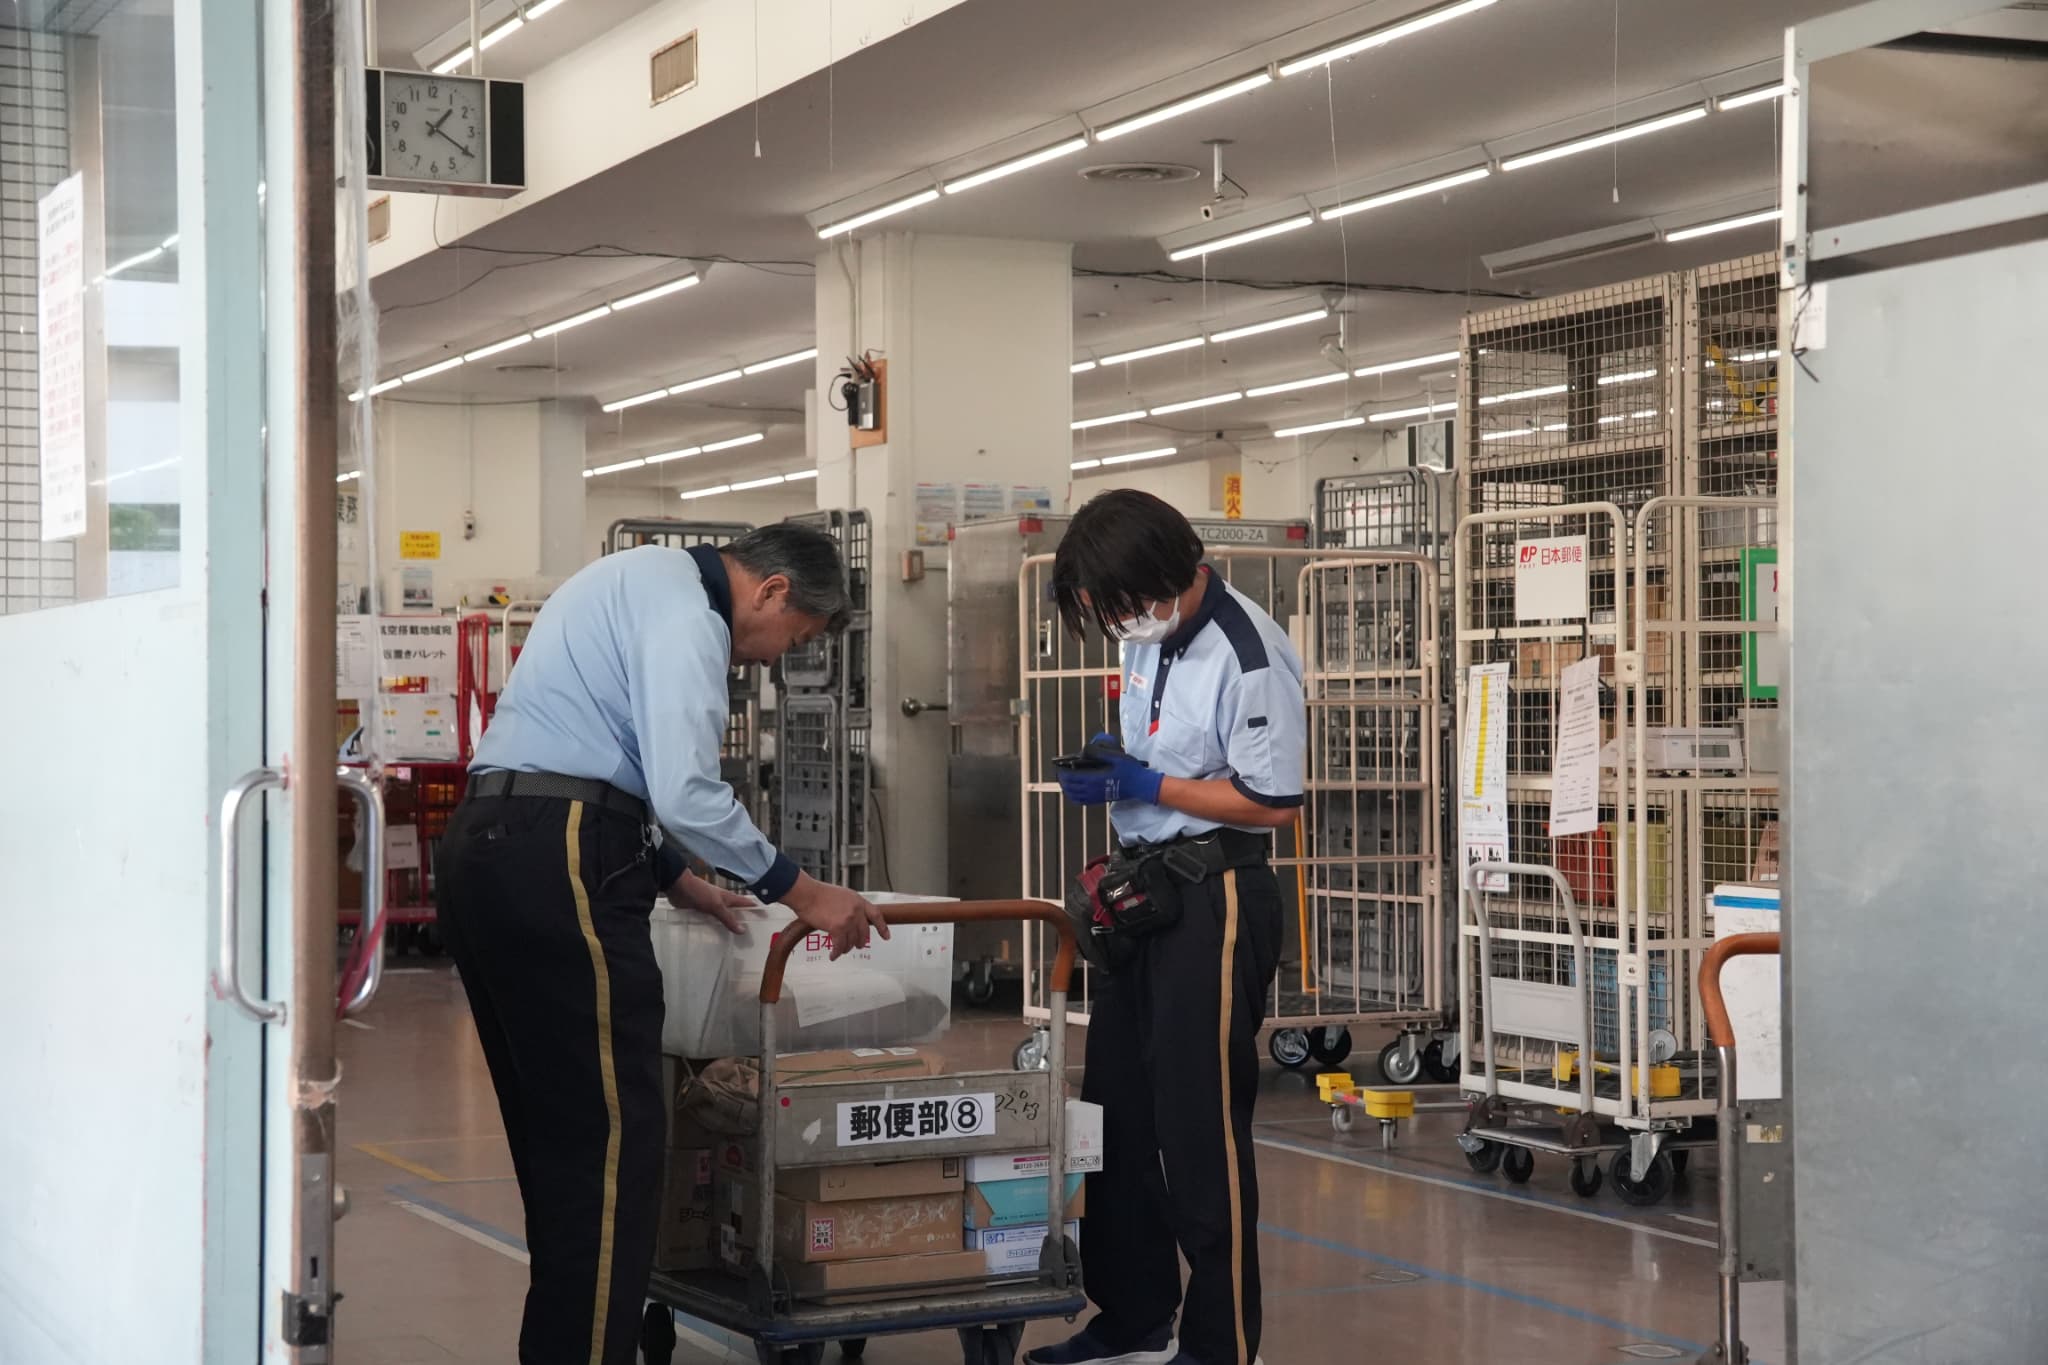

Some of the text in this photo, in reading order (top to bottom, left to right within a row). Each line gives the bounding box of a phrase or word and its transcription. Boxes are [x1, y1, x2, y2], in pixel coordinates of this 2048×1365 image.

[409, 87, 420, 102] 11
[428, 86, 438, 98] 12
[396, 102, 407, 114] 10
[461, 106, 468, 119] 2
[391, 120, 400, 132] 9
[467, 126, 475, 138] 3
[398, 139, 407, 152] 8
[414, 155, 421, 167] 7
[448, 157, 456, 169] 5
[430, 161, 439, 174] 6
[1226, 477, 1241, 520] 消火
[1541, 546, 1583, 565] 日本郵便
